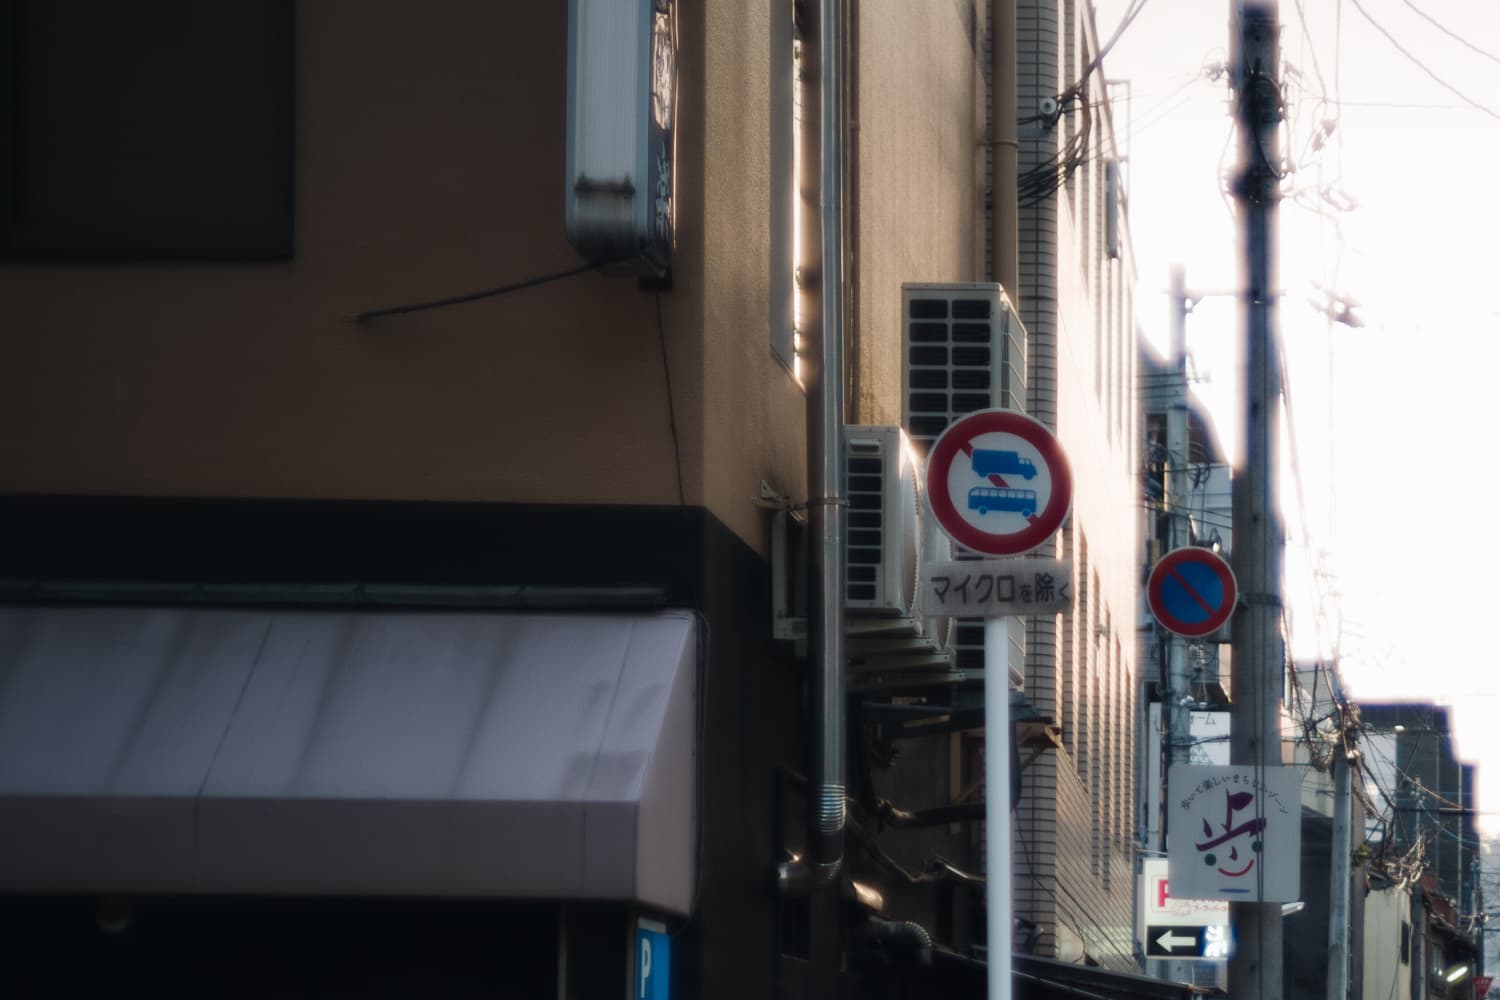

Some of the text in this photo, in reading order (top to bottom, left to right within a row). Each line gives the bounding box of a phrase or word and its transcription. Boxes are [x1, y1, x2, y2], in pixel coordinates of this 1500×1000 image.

[930, 572, 1071, 604] マイクロを除く
[641, 938, 651, 998] P
